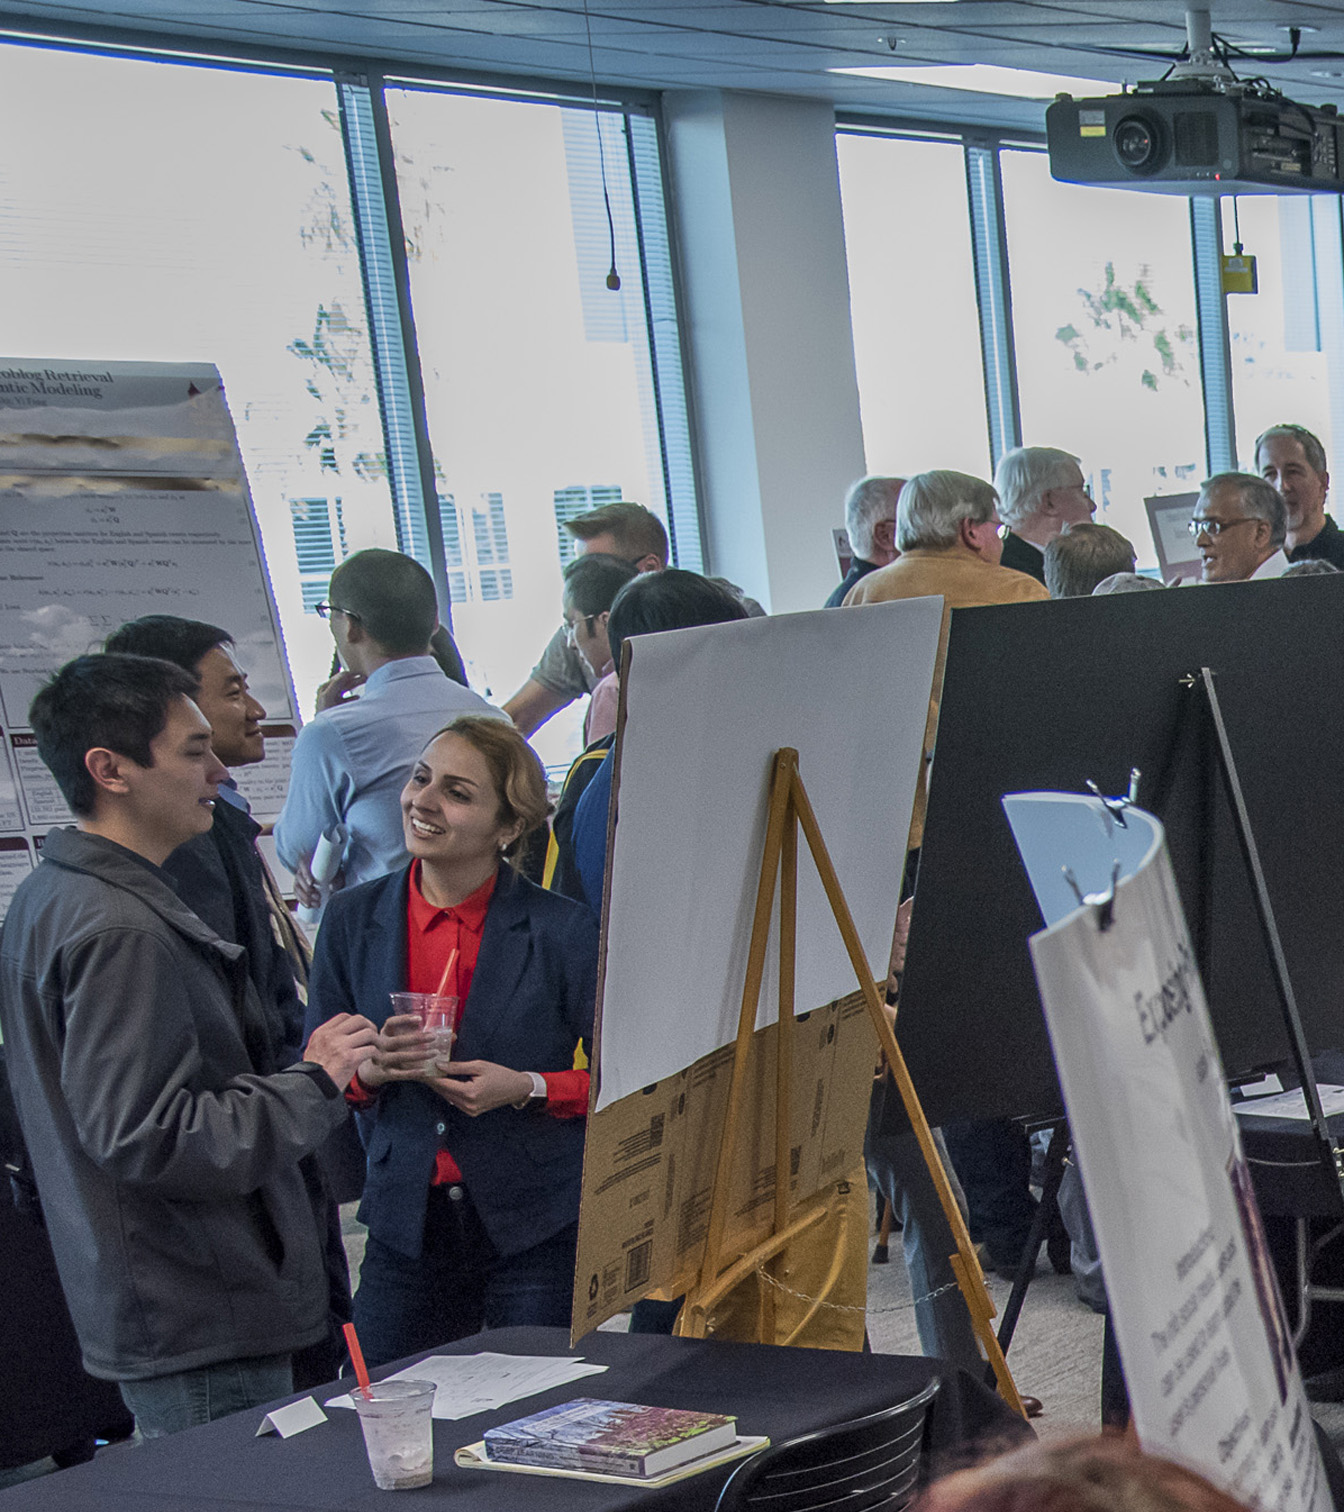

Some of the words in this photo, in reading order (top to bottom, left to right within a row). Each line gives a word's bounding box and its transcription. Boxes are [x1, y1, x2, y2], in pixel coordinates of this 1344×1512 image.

[0, 368, 43, 382] oblog
[44, 368, 114, 384] Retrieval
[30, 382, 103, 400] Modeling
